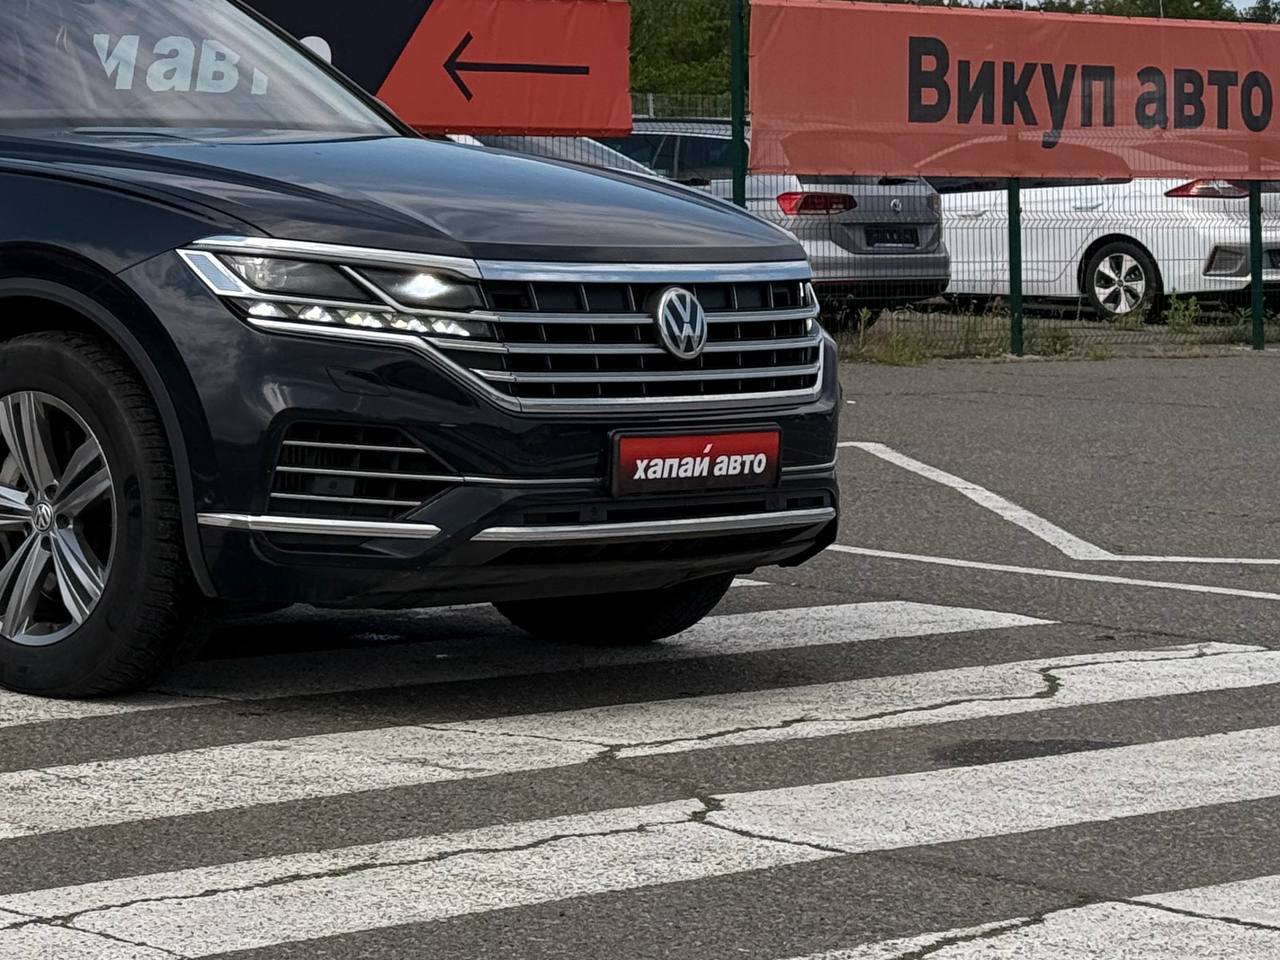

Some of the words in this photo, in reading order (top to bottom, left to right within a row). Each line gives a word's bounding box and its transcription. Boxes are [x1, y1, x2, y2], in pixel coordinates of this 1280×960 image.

[908, 36, 1115, 148] Викуп
[1135, 65, 1274, 132] авто
[633, 444, 713, 480] хапай
[713, 453, 767, 476] авто
